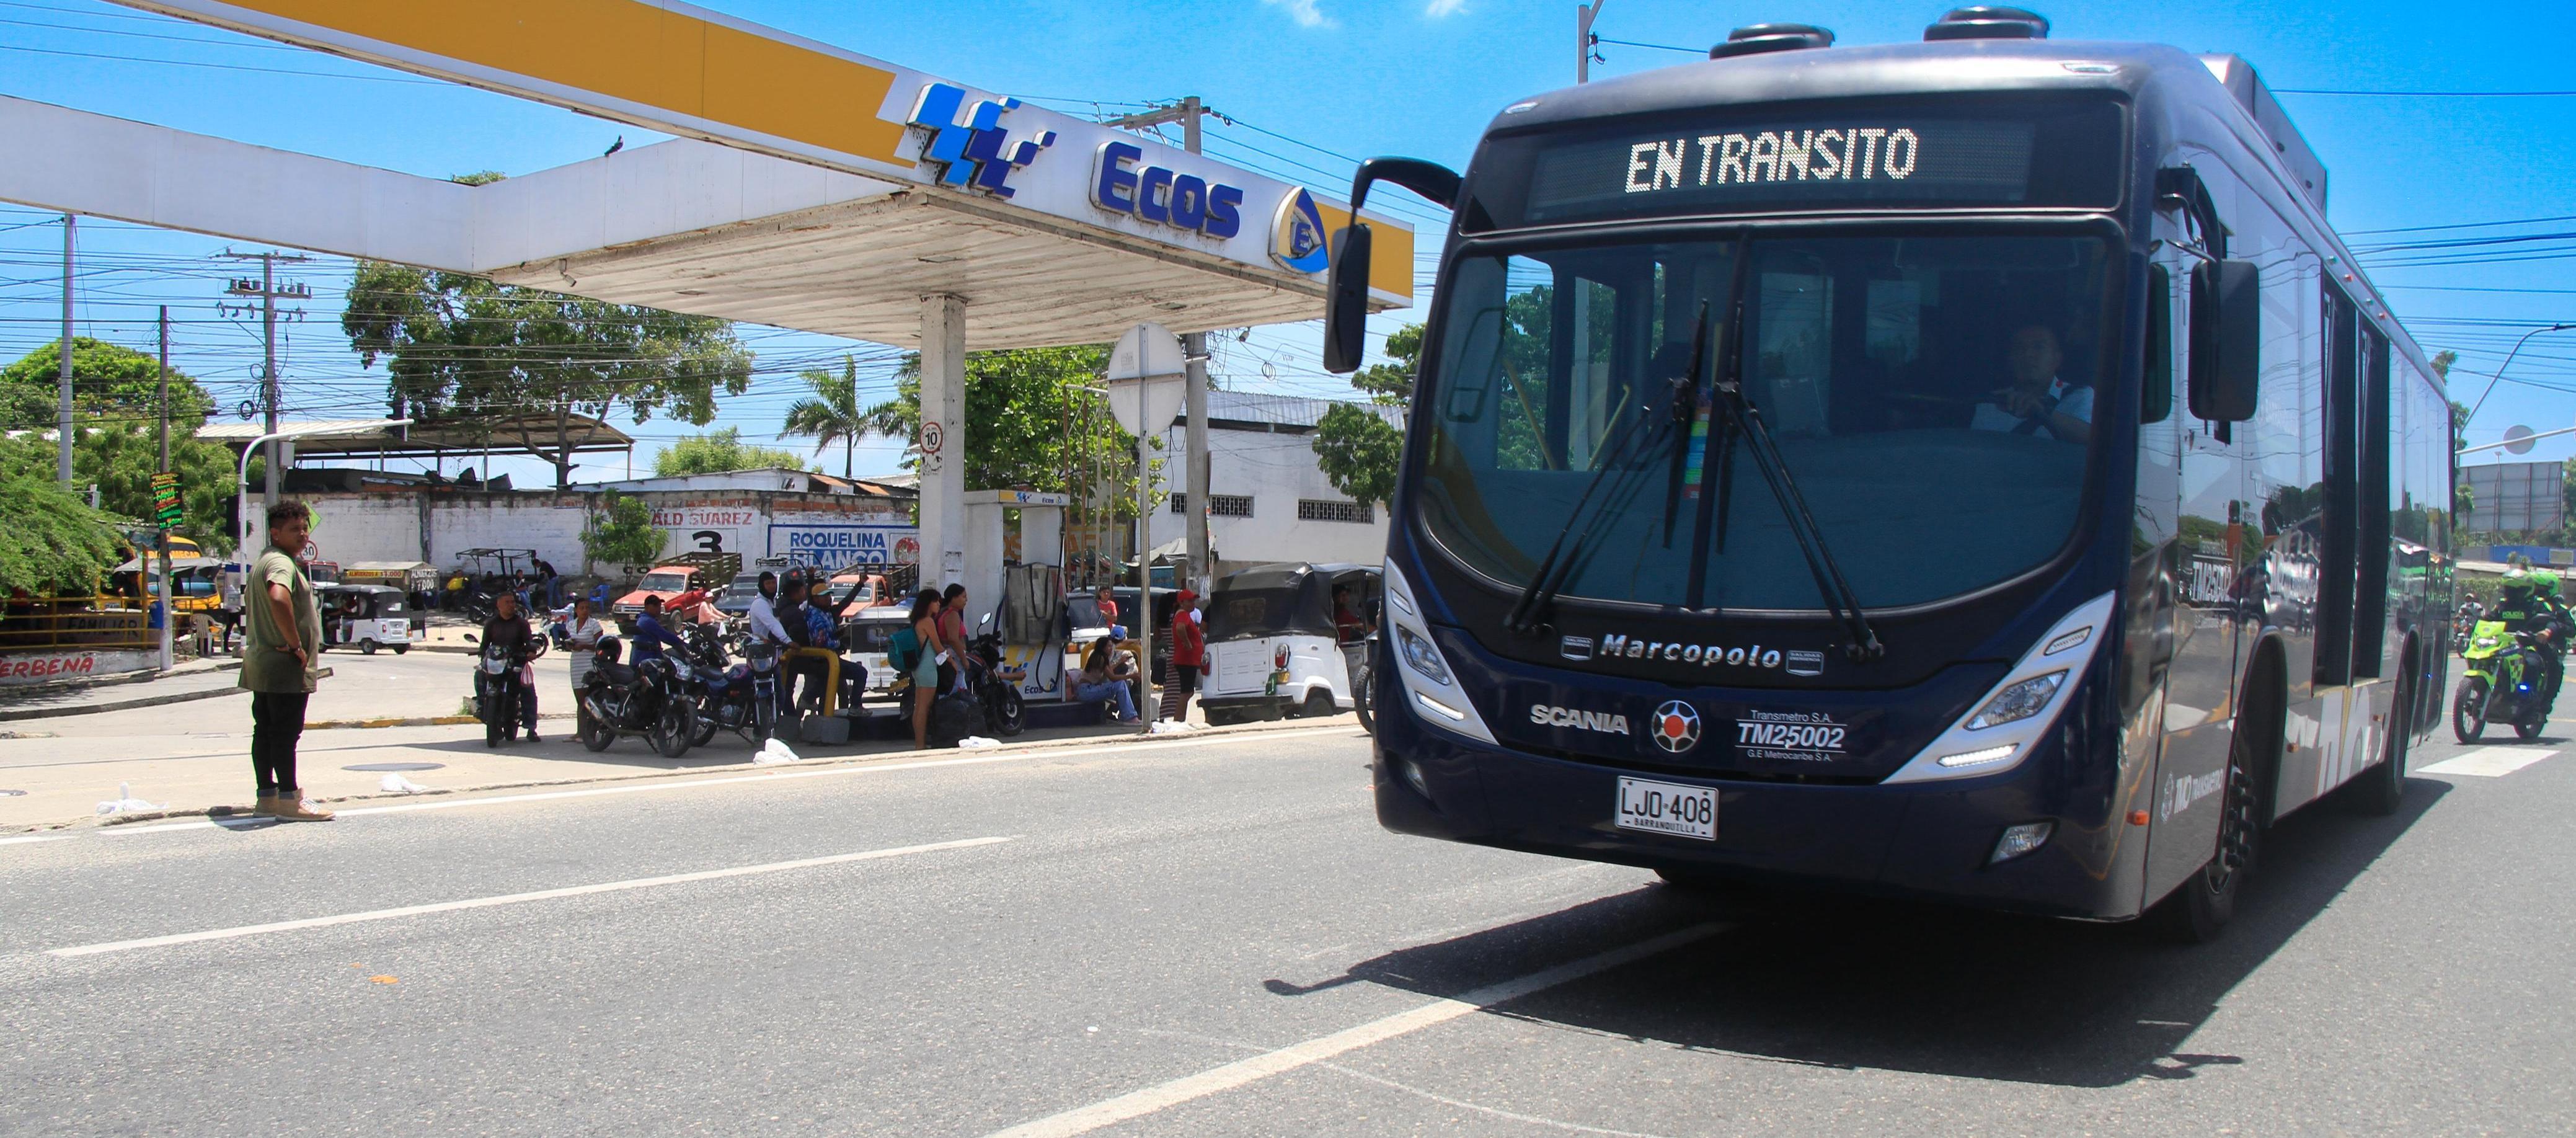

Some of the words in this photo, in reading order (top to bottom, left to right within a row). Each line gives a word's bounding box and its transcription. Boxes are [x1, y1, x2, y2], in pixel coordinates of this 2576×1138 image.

[1625, 138, 1685, 193] EN
[1697, 128, 1919, 186] TRANSITO
[925, 432, 937, 446] 10
[689, 512, 753, 526] SUAREZ
[790, 532, 886, 548] ROQUELINA
[303, 545, 314, 557] 30
[792, 550, 885, 569] BLANCO
[411, 569, 437, 579] ALMUERZOS
[1600, 634, 1781, 668] Marcopolo
[1530, 705, 1629, 736] SCANIA
[1751, 709, 1809, 722] Transmetro
[1811, 713, 1833, 723] S.A.
[1738, 722, 1845, 749] TM25002
[1764, 750, 1813, 761] Metrocaribe
[1634, 817, 1696, 833] BARRANQUILLA
